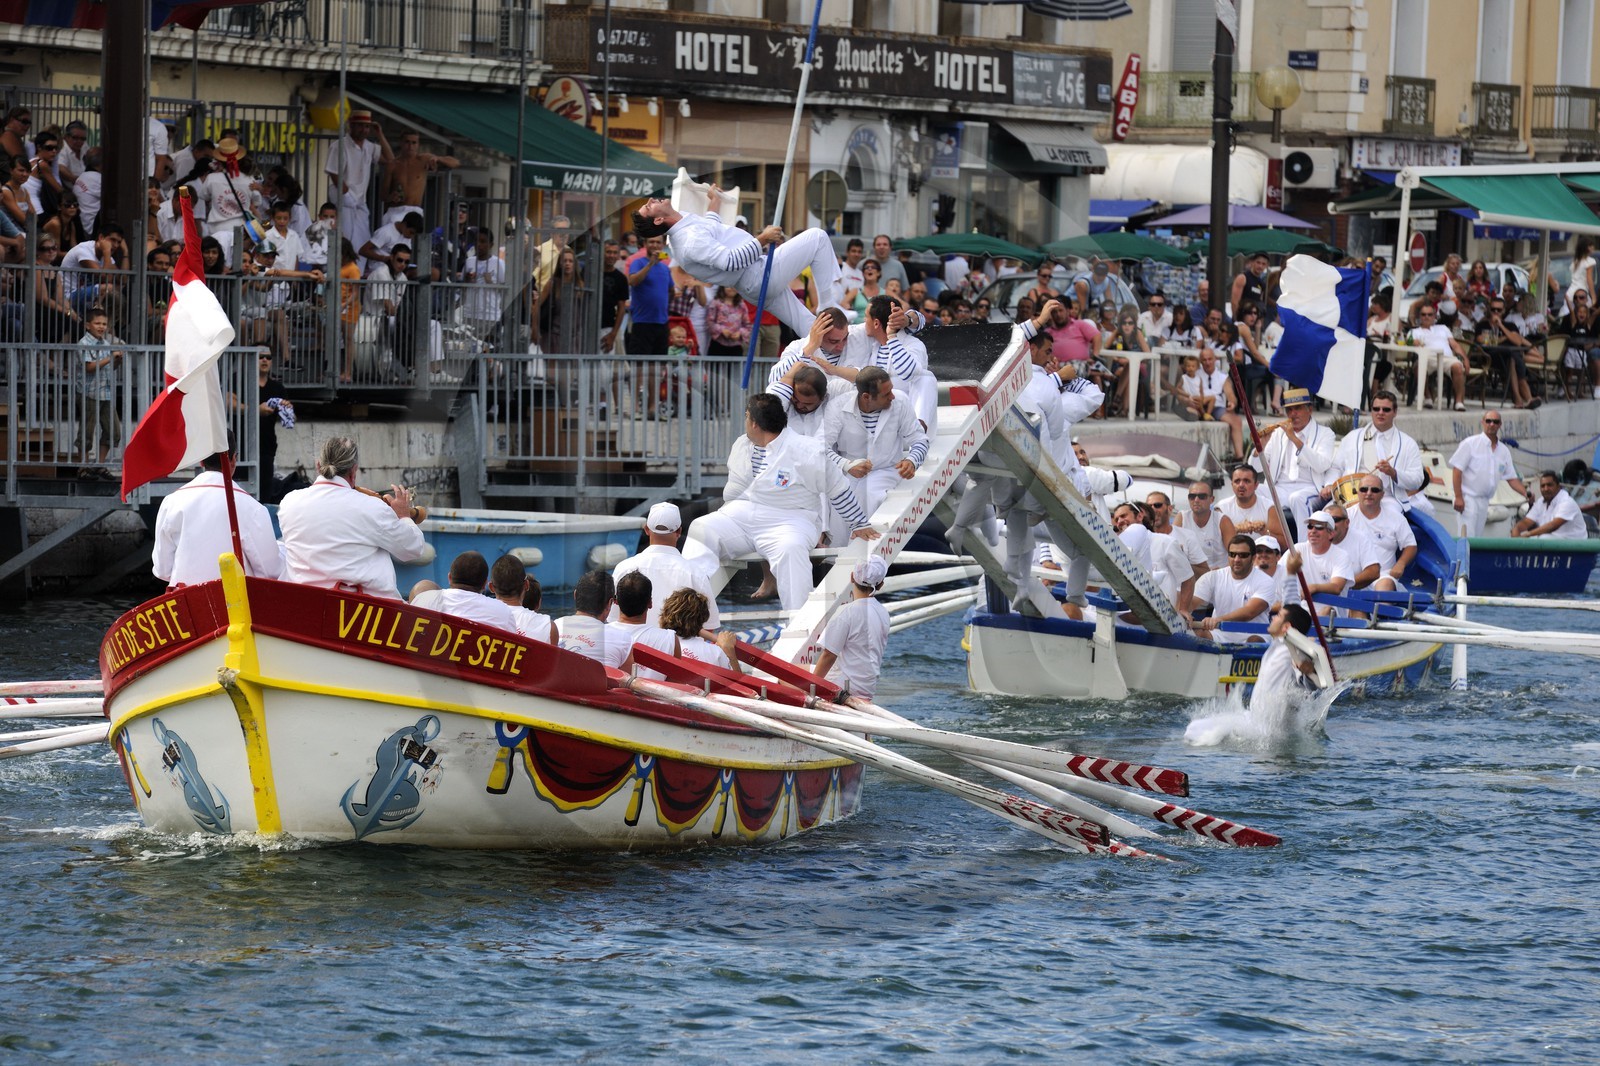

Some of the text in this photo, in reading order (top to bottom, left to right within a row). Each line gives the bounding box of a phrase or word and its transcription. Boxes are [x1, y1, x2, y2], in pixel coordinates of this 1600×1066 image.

[675, 31, 758, 75] HOTEL
[934, 51, 1007, 94] HOTEL
[1116, 56, 1140, 137] TABAC
[1045, 147, 1058, 160] LA
[1367, 140, 1383, 165] LE
[621, 177, 654, 195] PUB
[1494, 555, 1560, 569] CAMILLE
[120, 620, 146, 658] DE
[136, 599, 191, 650] SETE
[338, 600, 527, 674] VILLE DE SETE
